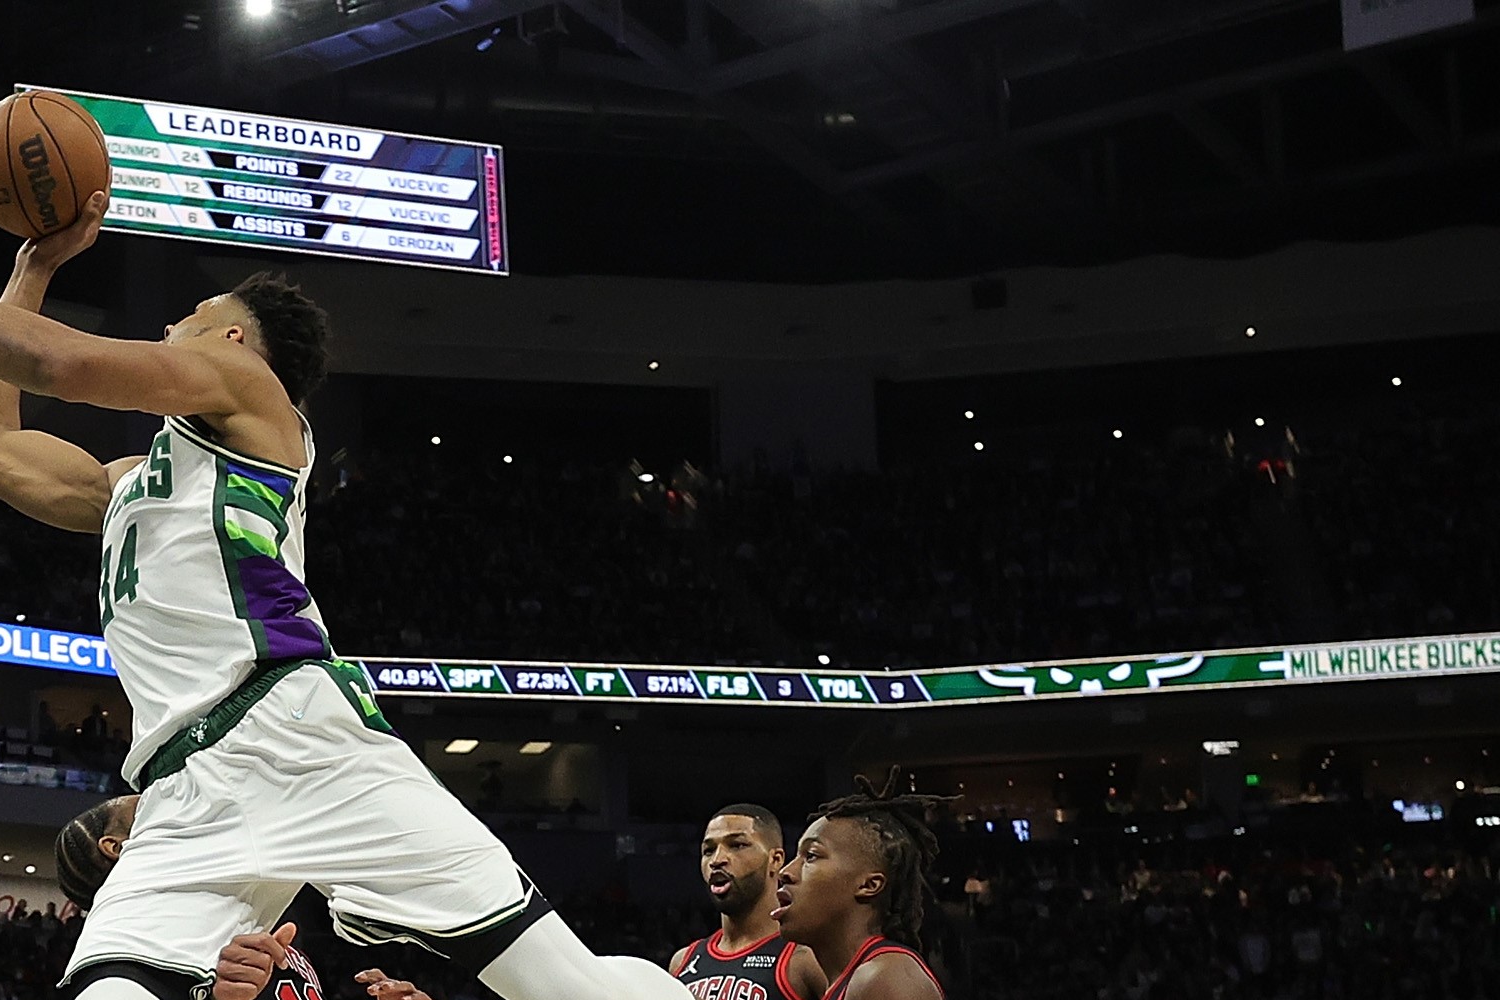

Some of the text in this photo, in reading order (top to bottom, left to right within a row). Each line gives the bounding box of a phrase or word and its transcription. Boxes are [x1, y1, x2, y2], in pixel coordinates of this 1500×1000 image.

[168, 111, 362, 152] LEADERBOARD
[19, 133, 60, 228] Wilson
[181, 151, 200, 163] 24
[235, 156, 299, 176] POINTS
[334, 169, 352, 182] 22
[388, 176, 449, 194] VUCEVIC
[185, 181, 199, 193] 12
[223, 184, 313, 208] REBOUNDS
[337, 199, 352, 212] 12
[389, 206, 450, 225] VUCEVIC
[188, 213, 198, 224] 6
[232, 216, 305, 238] ASSISTS
[341, 230, 351, 242] 6
[388, 235, 454, 252] DEROZAN
[1291, 638, 1500, 678] MILWAUKEE BUCKS
[378, 668, 904, 699] 40.9% 3PT 27.3% FT 57.1% FLS 3 TOL 3
